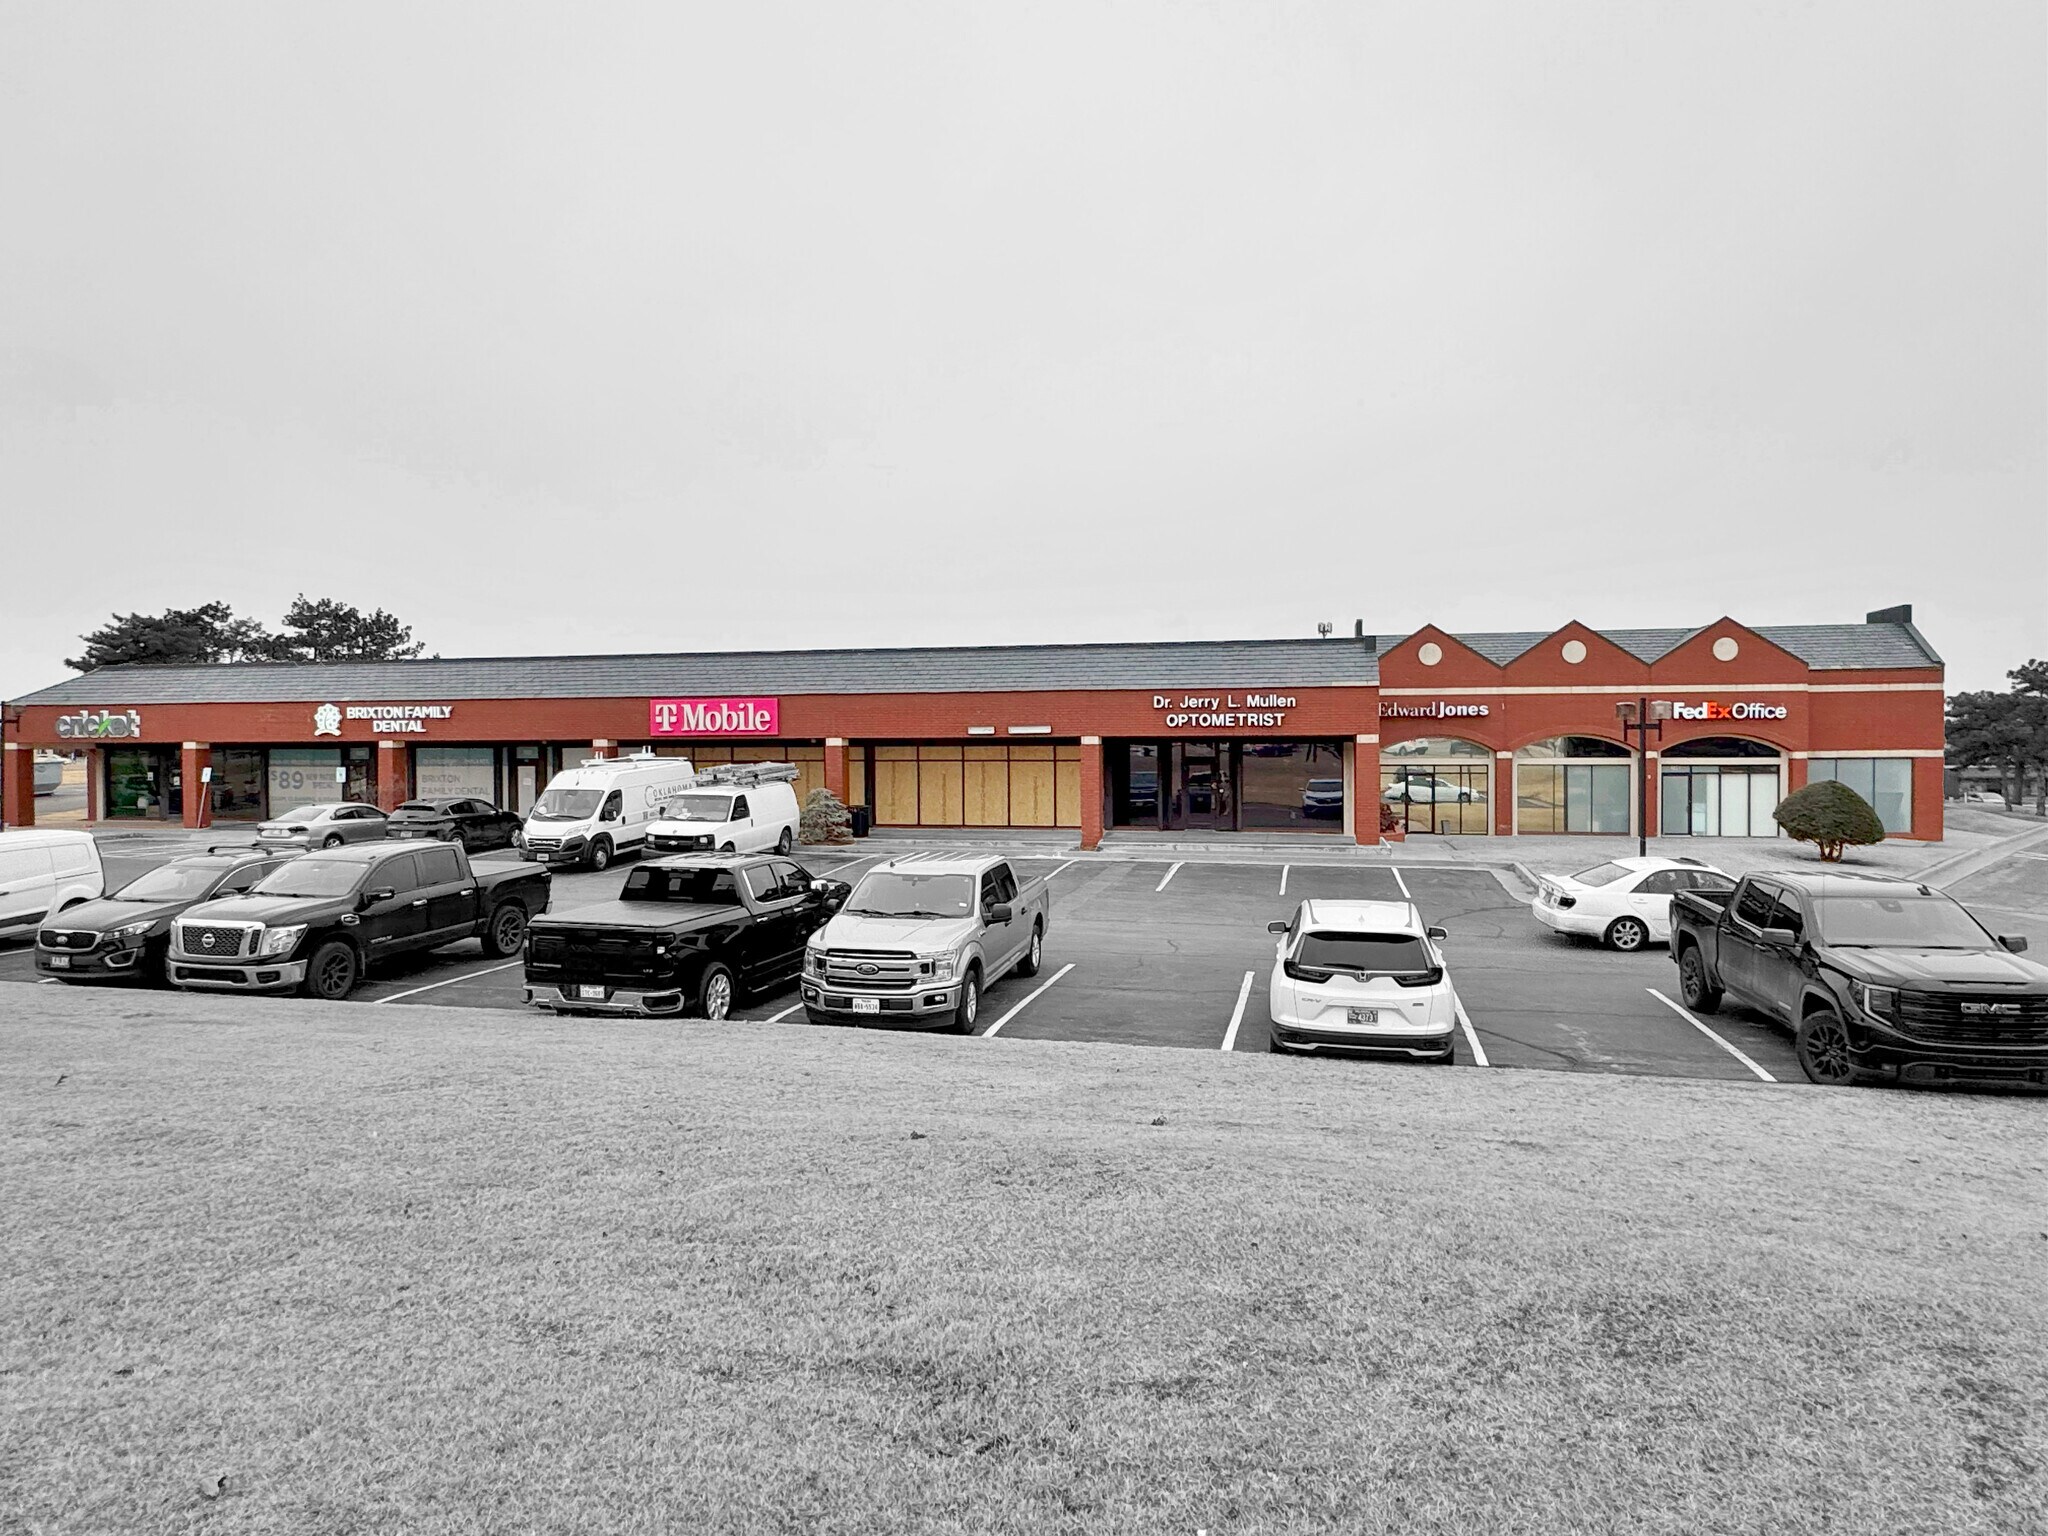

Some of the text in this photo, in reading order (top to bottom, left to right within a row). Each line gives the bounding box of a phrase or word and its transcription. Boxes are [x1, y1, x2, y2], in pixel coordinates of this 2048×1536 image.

[1153, 694, 1296, 710] Dr. Jerry L. Mullen
[346, 706, 453, 719] BRIXTON FAMILY
[1378, 701, 1489, 719] Edward Jones
[1673, 700, 1788, 719] FedEx Office
[681, 703, 771, 732] Mobile
[1166, 712, 1286, 727] OPTOMETRIST
[373, 720, 427, 733] DENTAL
[421, 774, 461, 783] BRIXTON
[421, 786, 490, 795] FAMILY DENTAL
[1960, 1002, 2021, 1014] GMC
